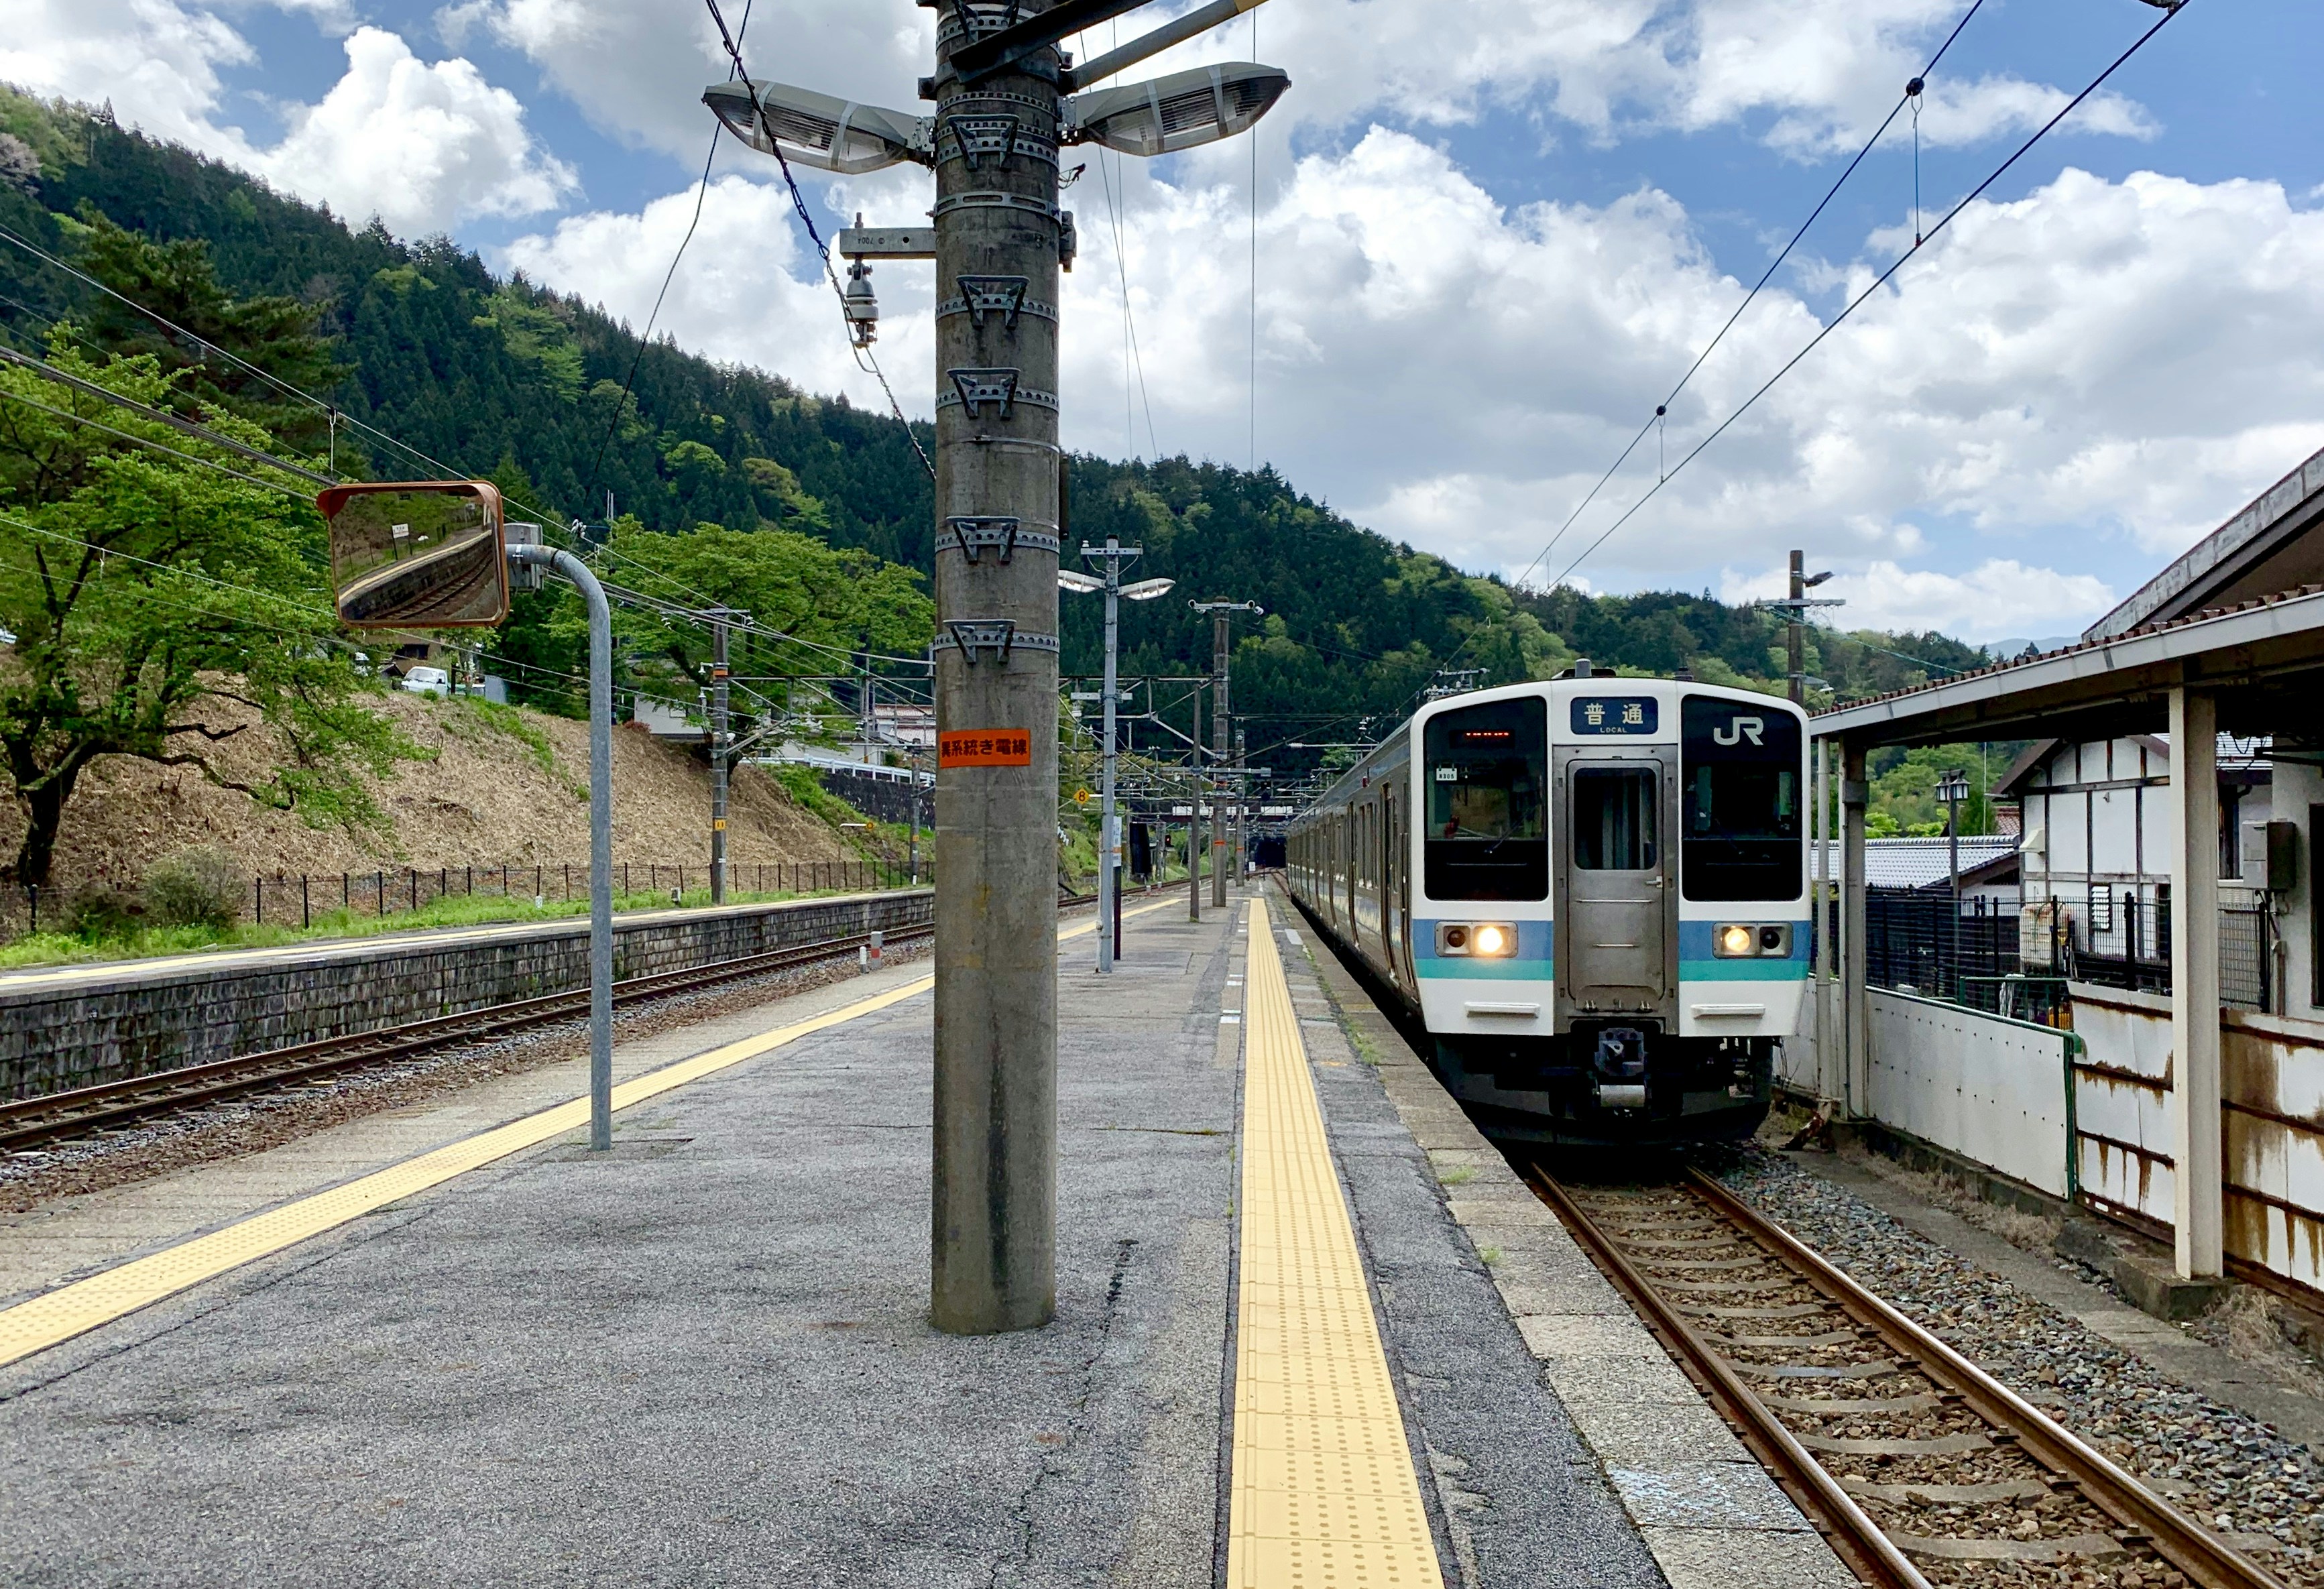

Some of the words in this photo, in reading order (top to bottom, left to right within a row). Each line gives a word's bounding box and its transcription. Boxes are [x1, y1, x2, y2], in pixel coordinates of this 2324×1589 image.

[1584, 703, 1643, 725] 普通
[1713, 717, 1764, 746] JR
[941, 738, 1027, 758] 異系統き電線
[1079, 790, 1086, 801] 8
